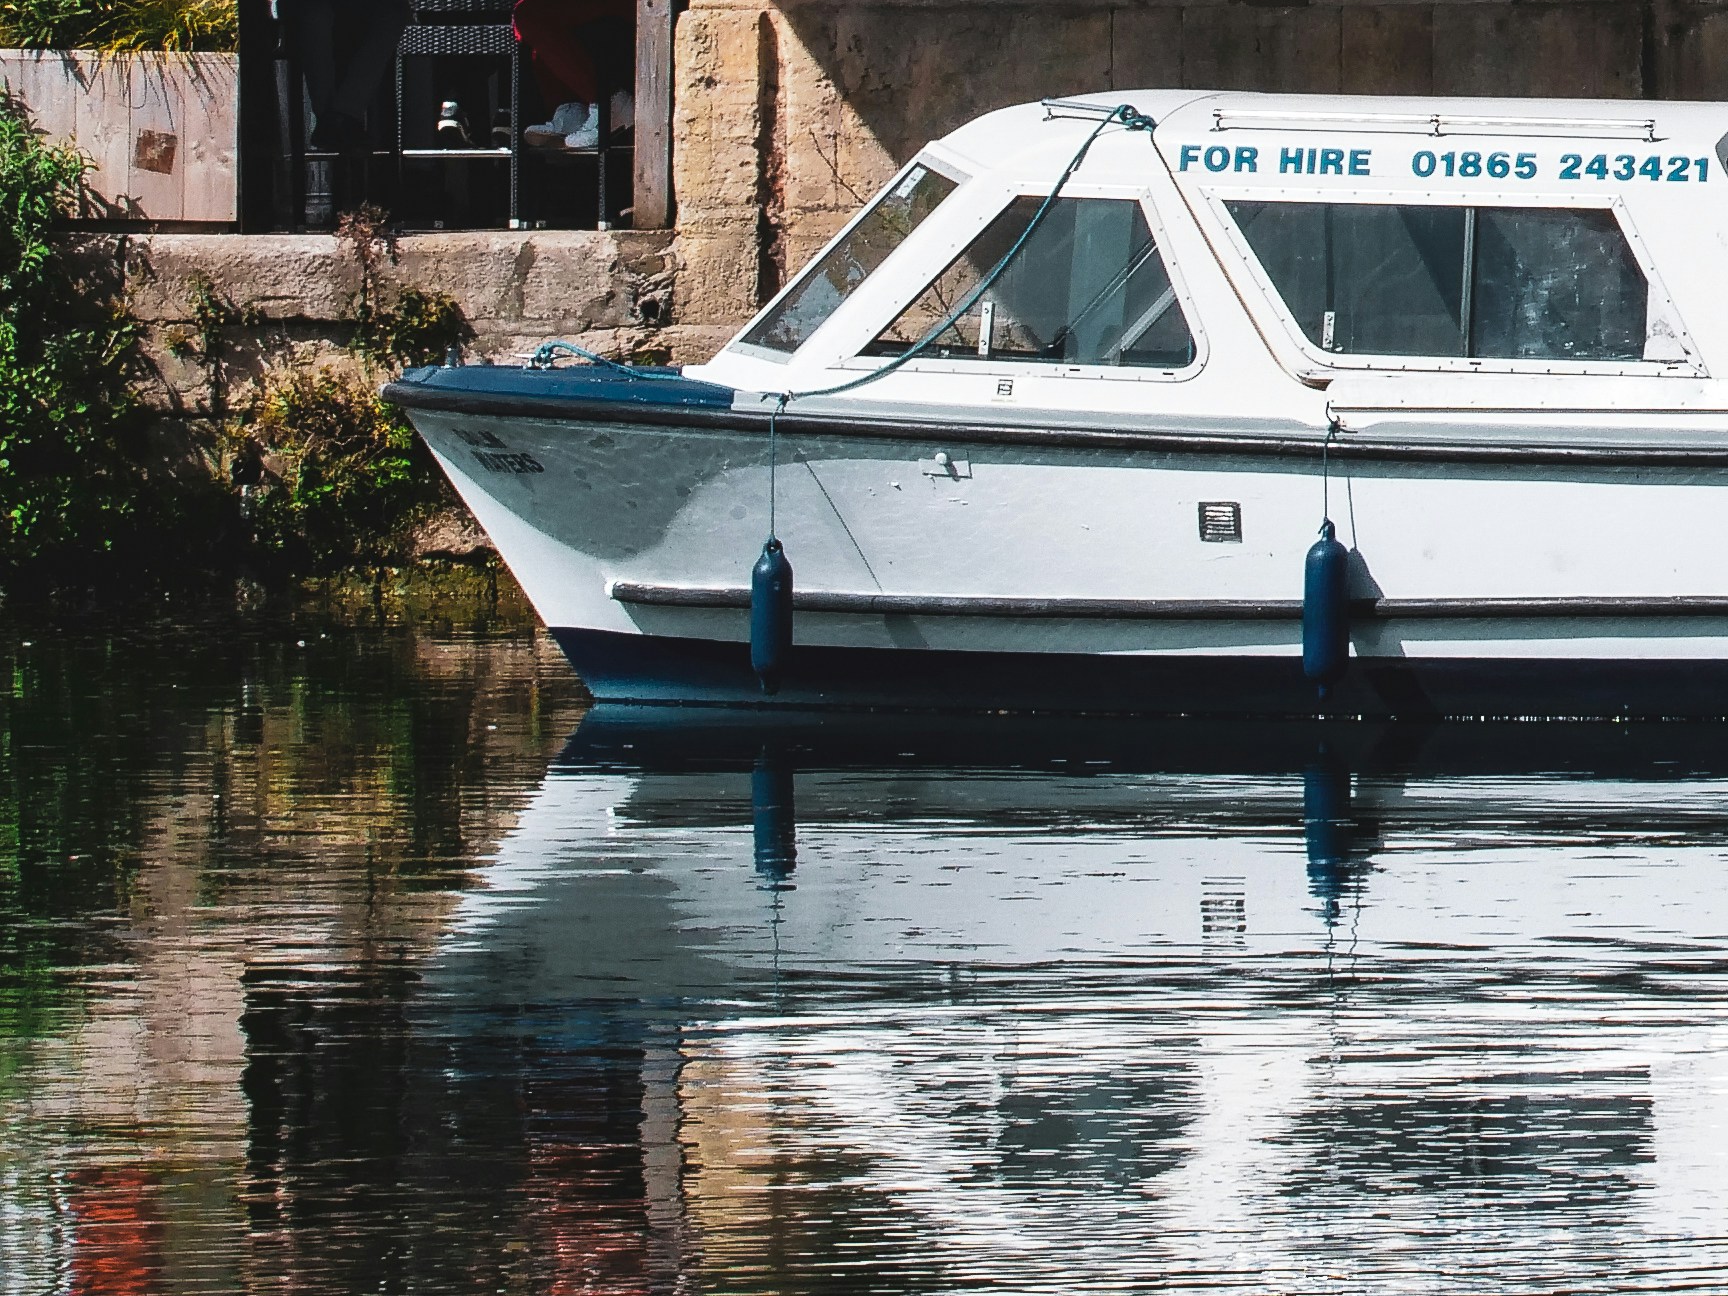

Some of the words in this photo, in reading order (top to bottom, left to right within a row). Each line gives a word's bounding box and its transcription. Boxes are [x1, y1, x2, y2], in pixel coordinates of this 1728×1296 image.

[1179, 144, 1260, 174] FOR
[1278, 146, 1373, 177] HIRE
[1410, 149, 1539, 181] 01865
[1557, 153, 1710, 184] 243421
